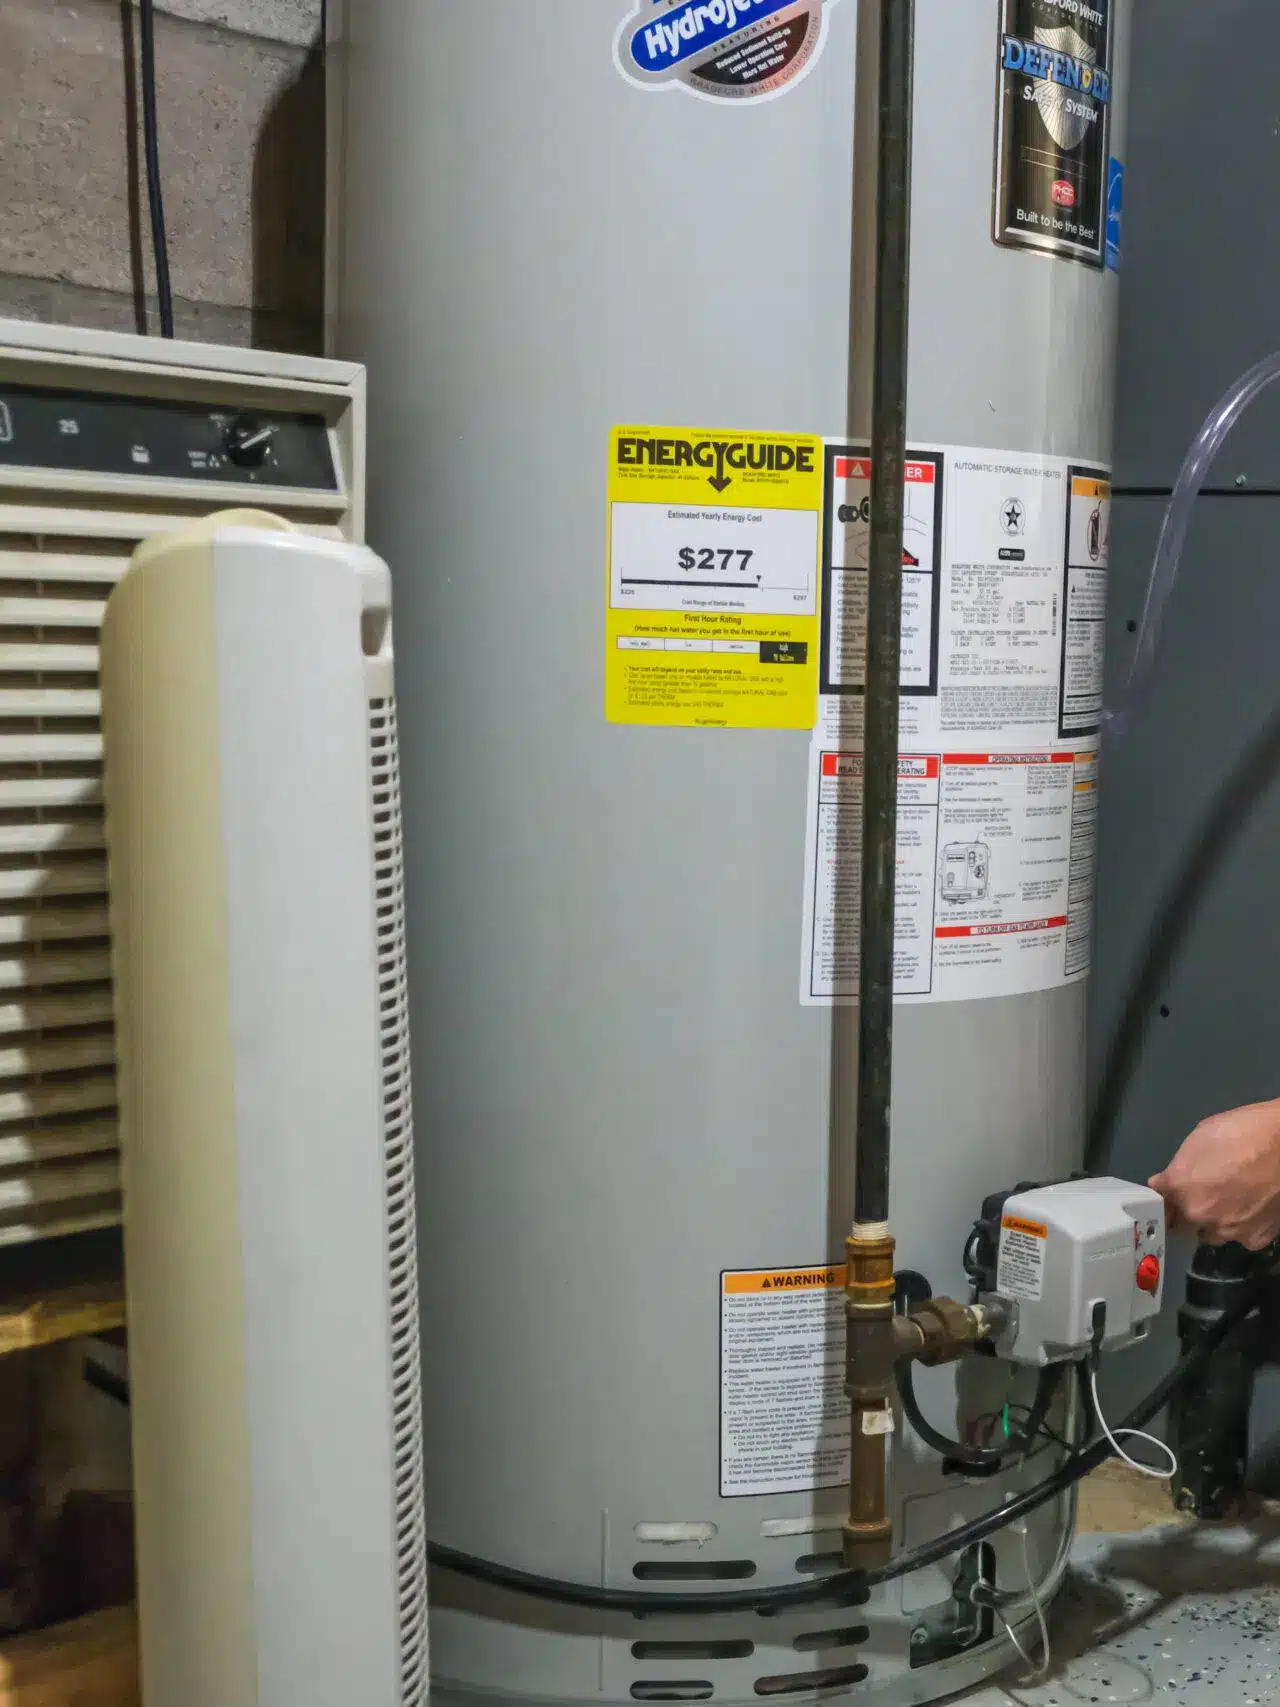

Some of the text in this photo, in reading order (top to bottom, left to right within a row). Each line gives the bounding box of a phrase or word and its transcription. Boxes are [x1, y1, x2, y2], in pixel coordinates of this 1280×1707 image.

[1080, 3, 1103, 26] WHITE
[1003, 38, 1111, 104] DEFENDER
[1065, 98, 1098, 123] SYSTEM
[1016, 208, 1095, 240] Built to be the Best
[617, 437, 815, 473] ENERGYGUIDE
[954, 462, 992, 473] AUTOMATIC
[667, 510, 763, 523] Estimated Yearly Energy Cost
[678, 546, 754, 571] $277
[684, 613, 742, 625] First Hour Rating
[772, 1272, 835, 1287] WARNING
